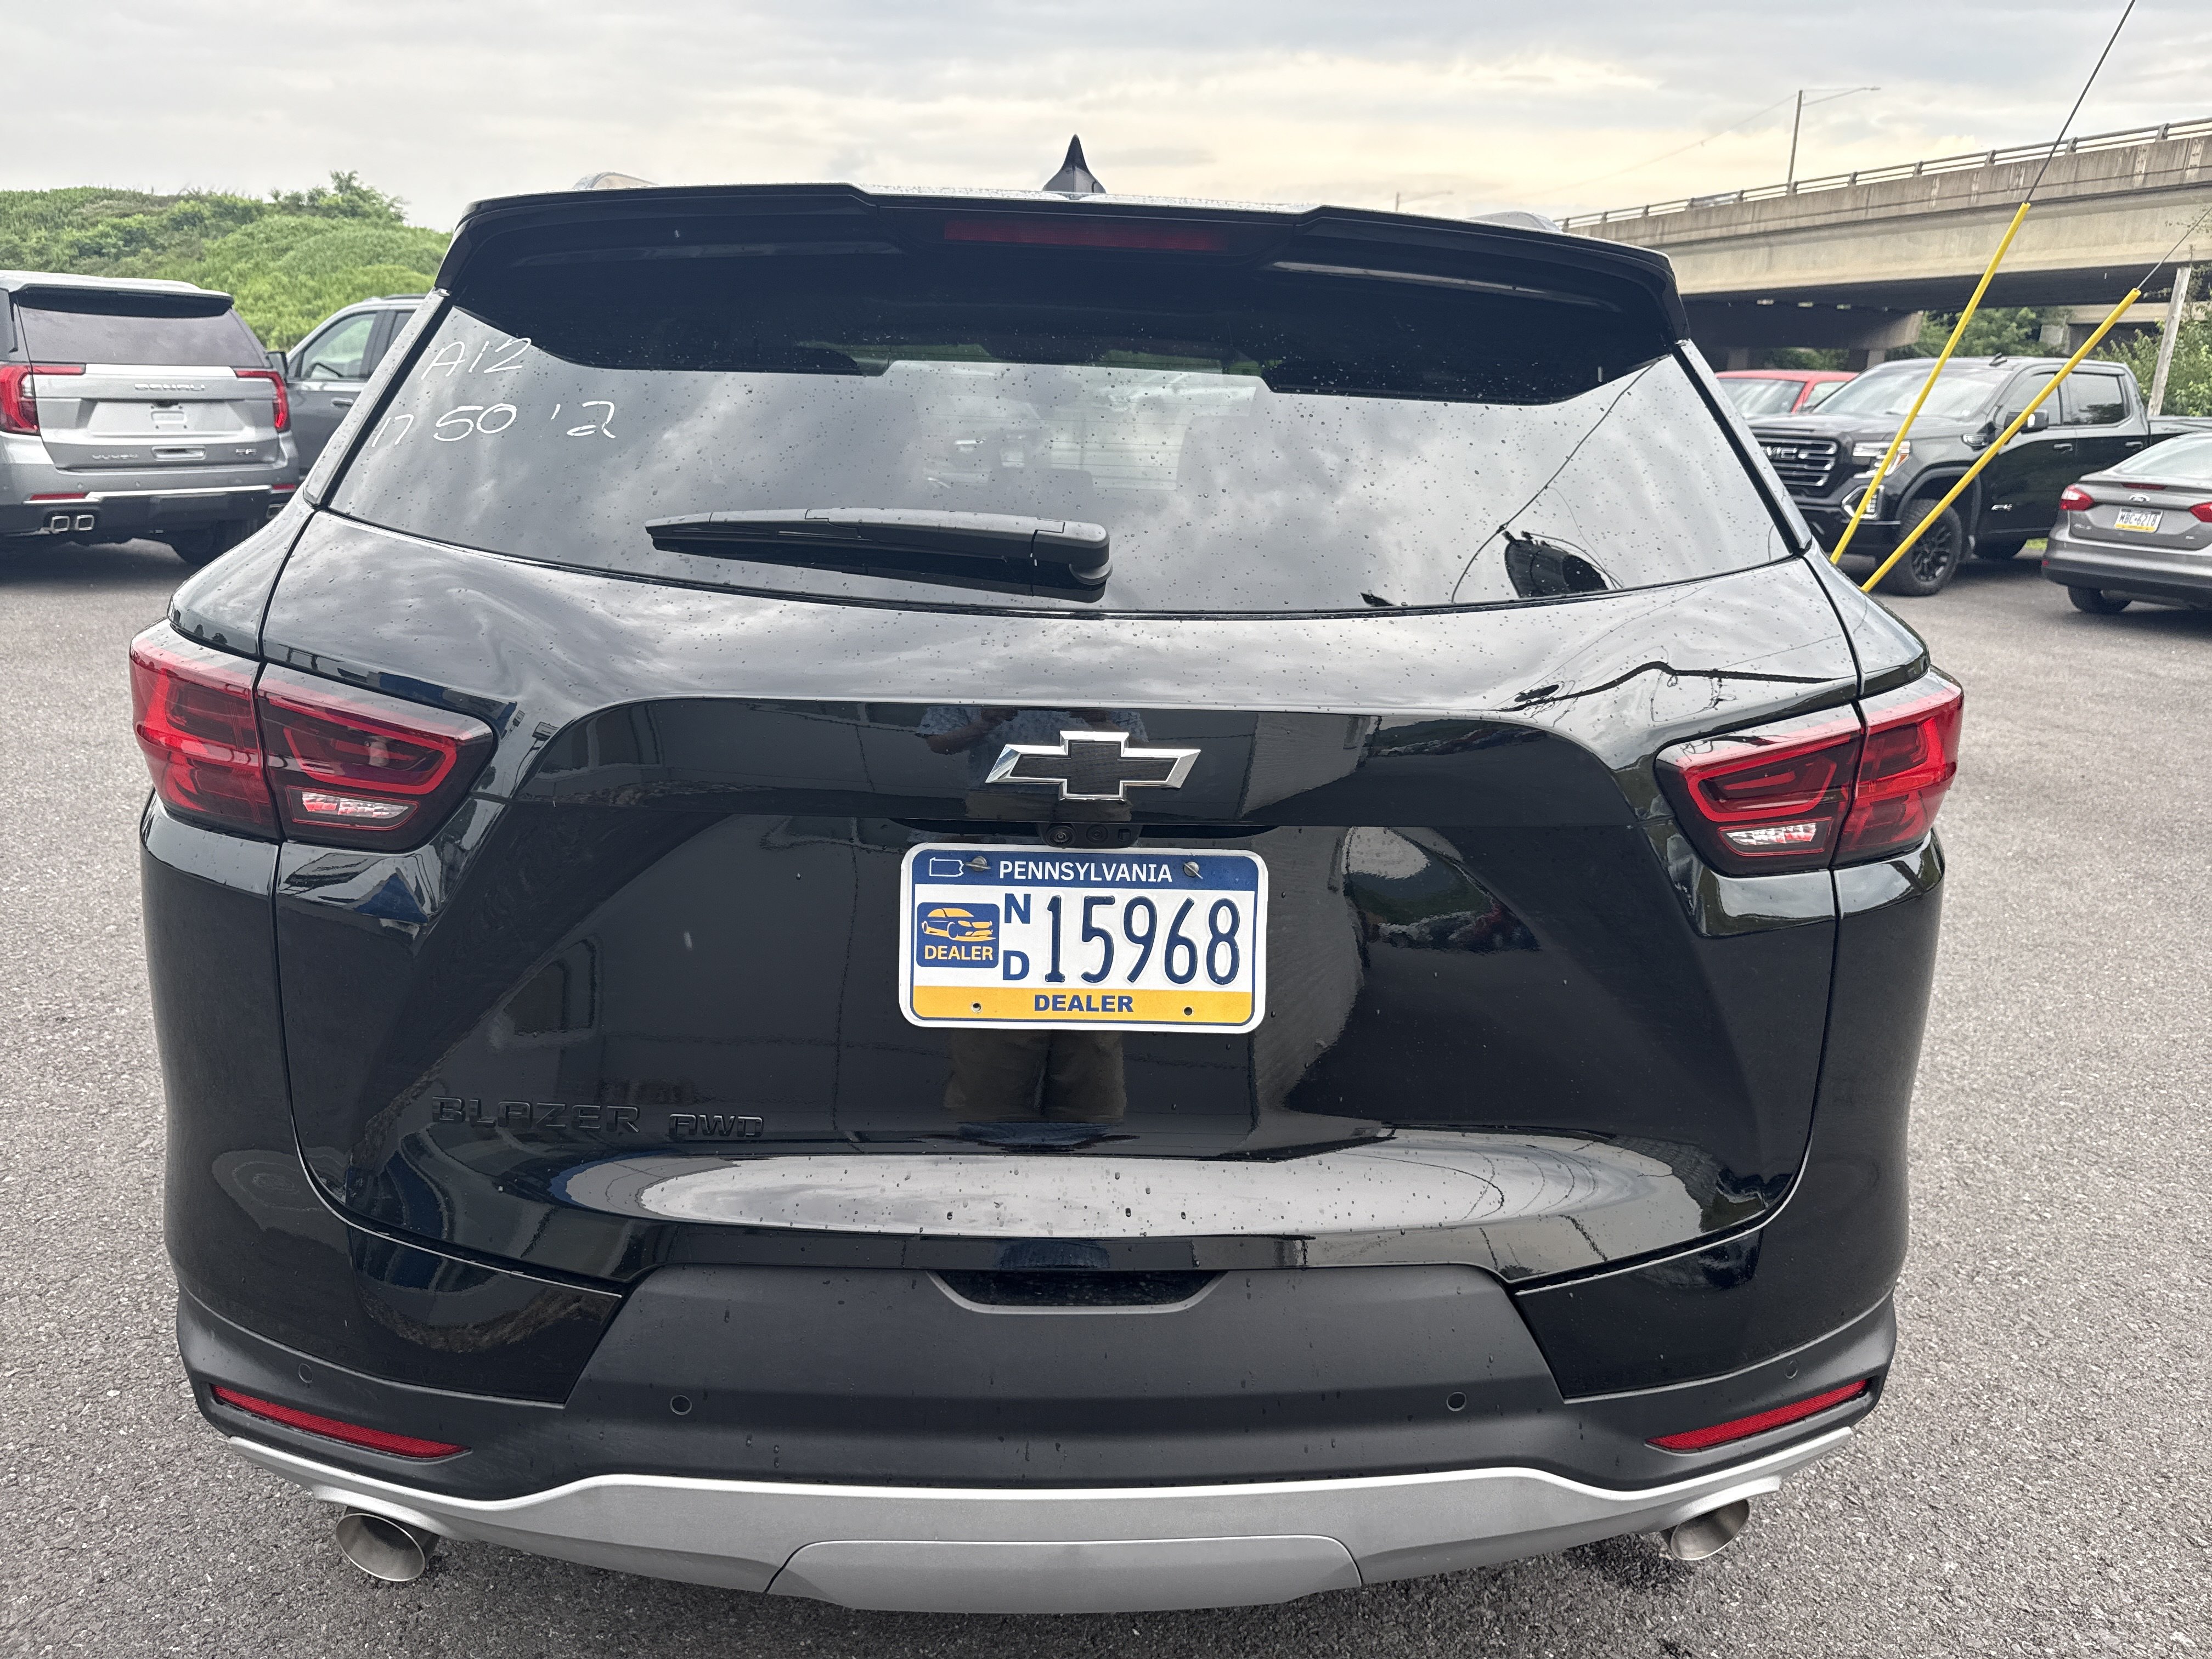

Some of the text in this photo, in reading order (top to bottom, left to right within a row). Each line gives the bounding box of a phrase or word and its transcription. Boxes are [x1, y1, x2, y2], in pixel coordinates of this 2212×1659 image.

[421, 338, 532, 380] A12
[1760, 446, 1798, 460] MC
[1000, 861, 1173, 882] PENNSYLVANIA
[1004, 893, 1031, 924] N
[925, 945, 993, 961] DEALER
[1044, 895, 1240, 985] 15968
[1002, 950, 1030, 981] D
[1034, 994, 1134, 1012] DEALER
[432, 1096, 765, 1138] BLAZER AWD
